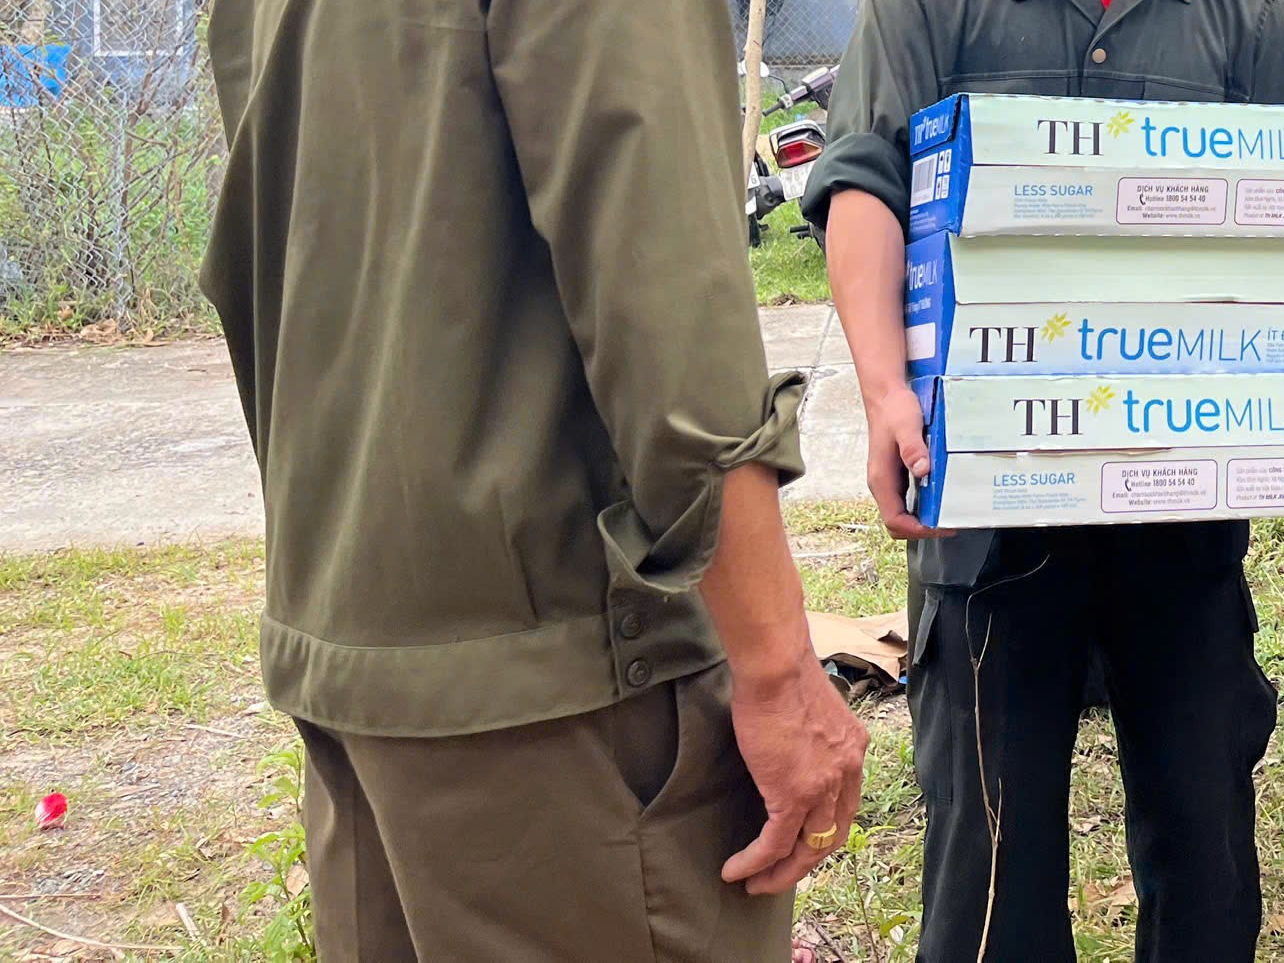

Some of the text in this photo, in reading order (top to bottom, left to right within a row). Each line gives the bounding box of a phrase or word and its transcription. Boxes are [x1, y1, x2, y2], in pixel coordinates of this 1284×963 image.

[1037, 119, 1104, 156] TH
[1014, 184, 1093, 196] LESS SUGAR
[1166, 184, 1189, 193] KHÁCH
[1198, 195, 1206, 203] 40
[1267, 327, 1279, 341] ÍT
[969, 326, 1039, 363] TH
[1013, 398, 1084, 436] TH
[1153, 467, 1176, 476] KHÁCH
[993, 472, 1075, 486] LESS SUGAR
[1178, 478, 1185, 486] 54
[1187, 478, 1195, 486] 40
